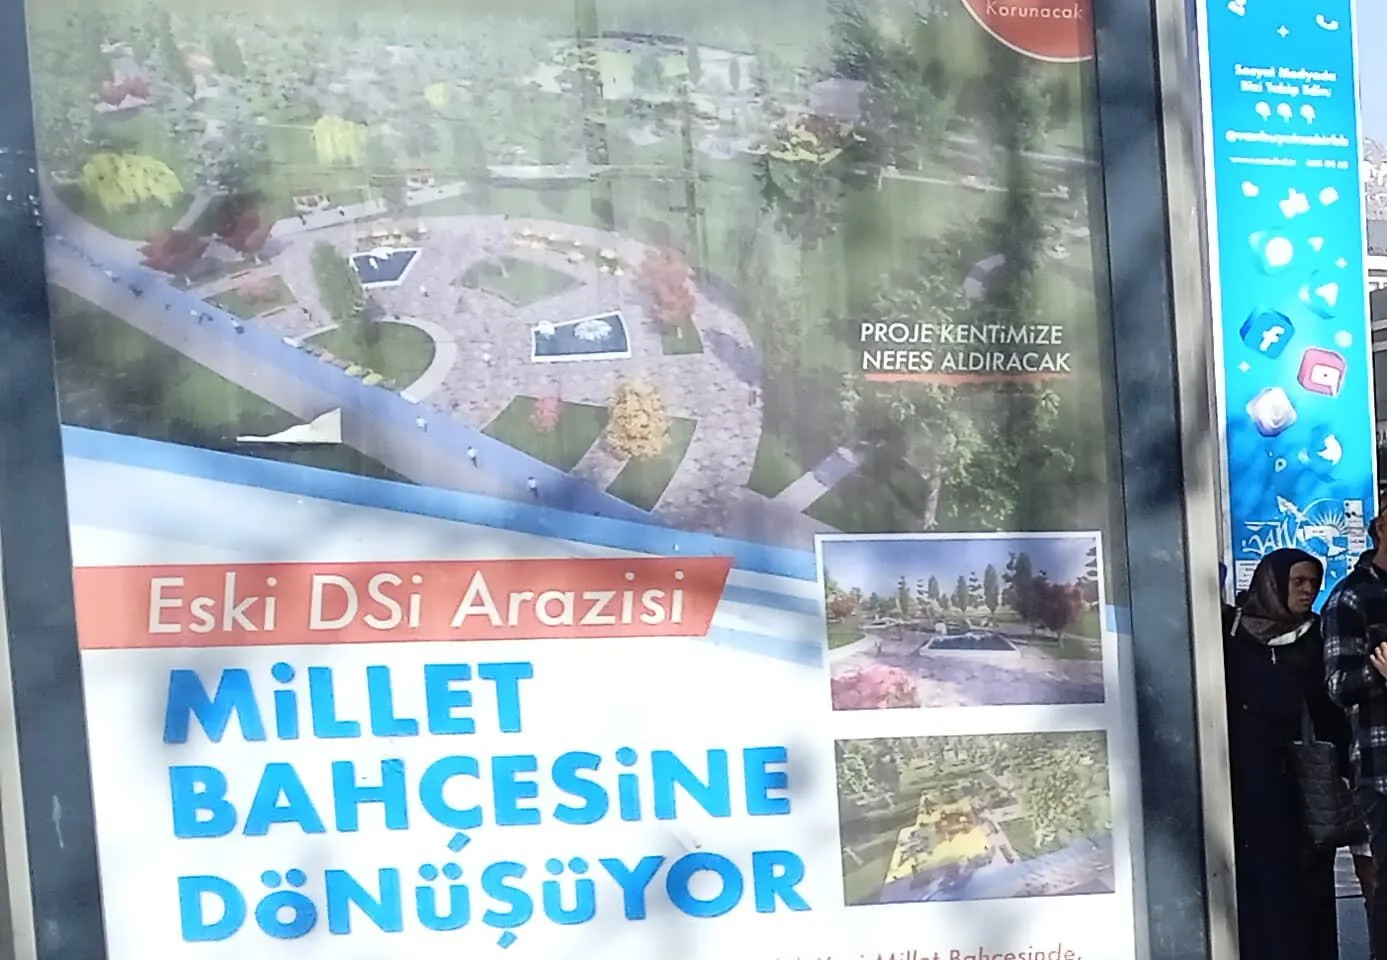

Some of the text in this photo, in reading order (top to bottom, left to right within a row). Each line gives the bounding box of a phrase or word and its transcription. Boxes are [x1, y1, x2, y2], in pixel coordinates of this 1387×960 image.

[986, 1, 1083, 19] Korunacak
[860, 322, 934, 343] PROJE
[862, 350, 1071, 372] NEFES ALDIRACAK
[147, 571, 276, 635] Eski
[451, 569, 684, 630] Arazisi
